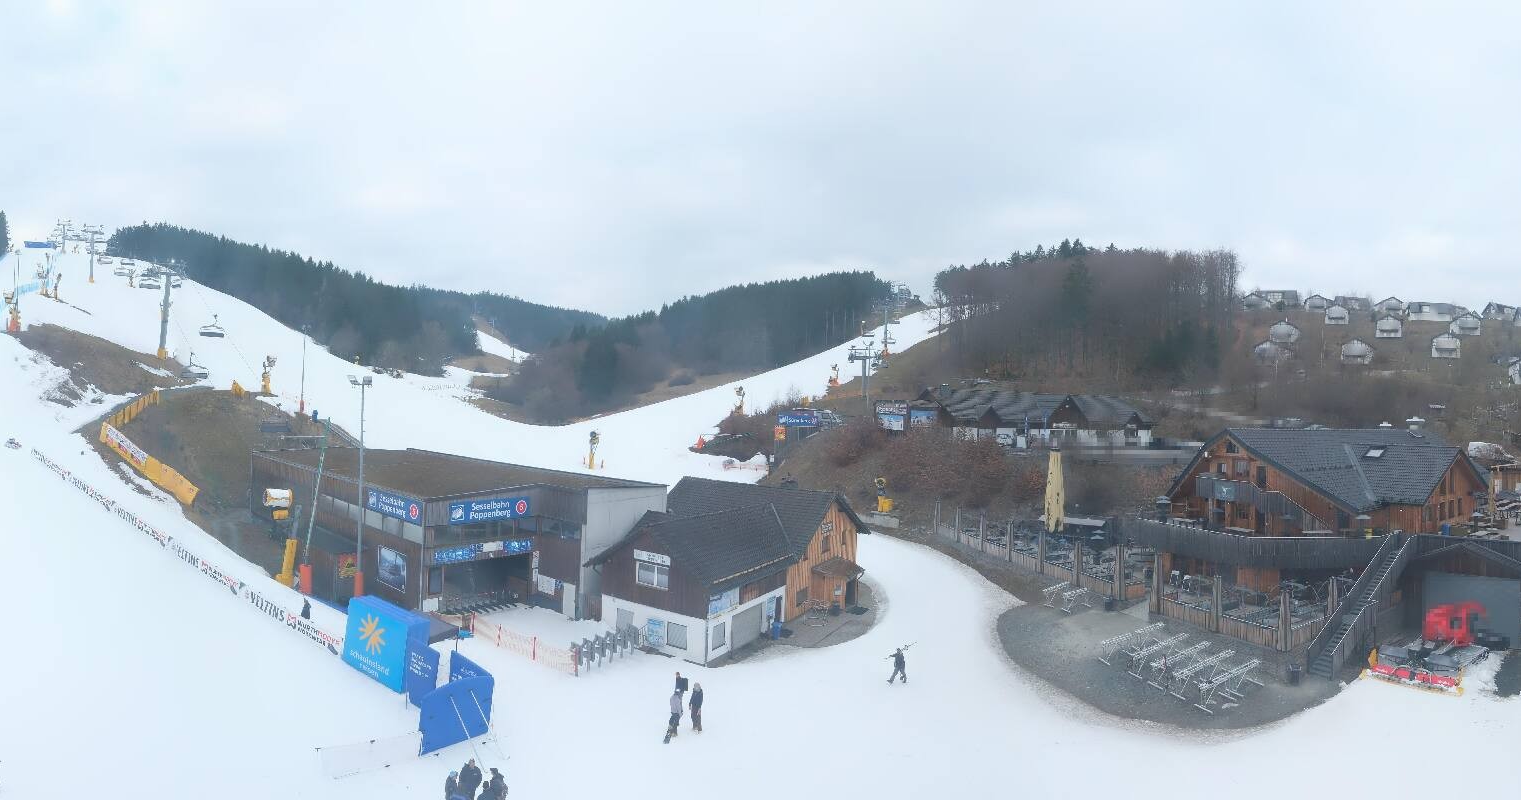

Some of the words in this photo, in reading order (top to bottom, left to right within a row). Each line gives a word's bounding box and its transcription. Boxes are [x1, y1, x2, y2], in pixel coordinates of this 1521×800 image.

[469, 509, 511, 521] Poppenberg
[471, 500, 510, 512] Sesselbahn
[250, 590, 285, 623] VELTINS
[350, 649, 390, 676] schauinsland
